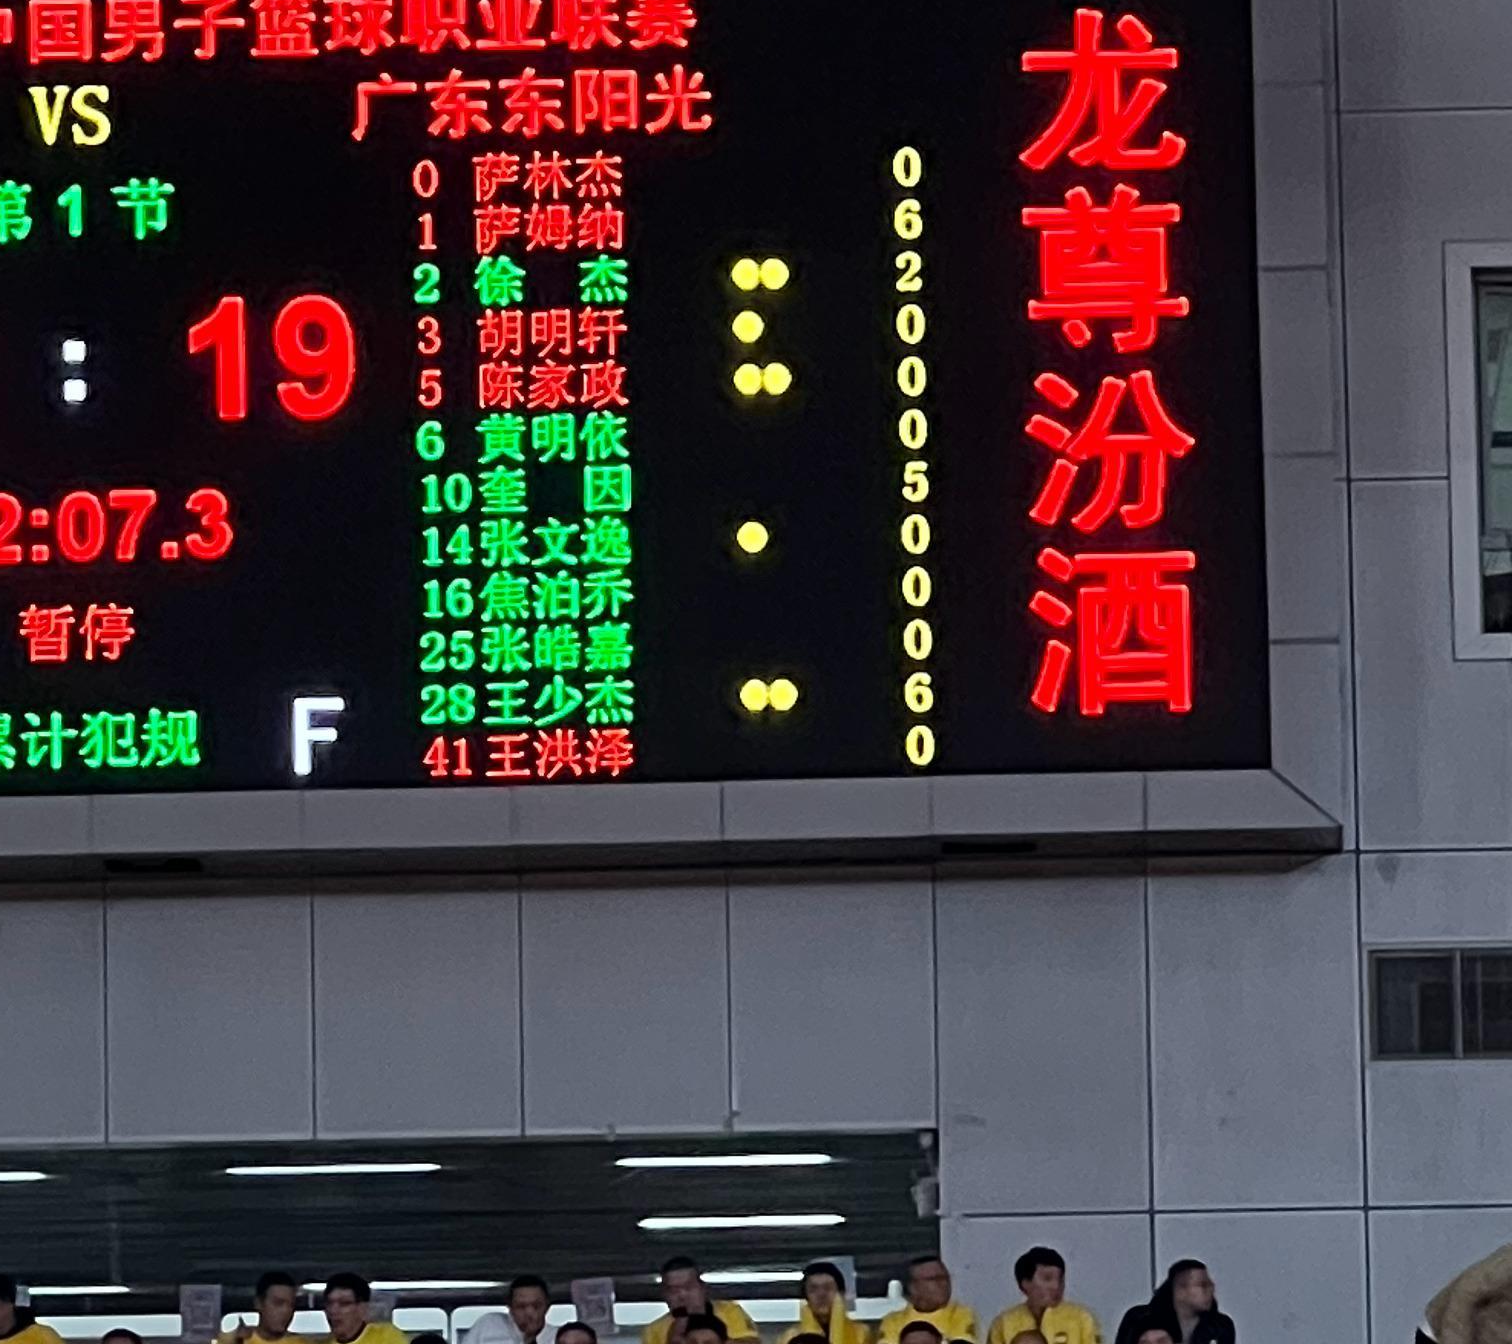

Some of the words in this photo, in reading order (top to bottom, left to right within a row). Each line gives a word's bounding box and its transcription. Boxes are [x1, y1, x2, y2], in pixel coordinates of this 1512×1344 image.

[28, 84, 112, 147] VS
[352, 64, 715, 143] 广东东阳光
[413, 157, 439, 197] 0
[472, 150, 623, 201] 萨林杰
[893, 147, 921, 187] 0
[419, 210, 437, 250] 1
[474, 202, 624, 254] 萨姆纳
[894, 199, 922, 240] 6
[414, 263, 440, 304] 2
[895, 251, 922, 292] 2
[188, 294, 357, 421] 19
[418, 316, 441, 354] 3
[477, 308, 628, 357] 胡明轩
[896, 304, 925, 344] 0
[419, 369, 441, 408] 5
[478, 360, 629, 409] 陈家政
[898, 356, 926, 397] 0
[1019, 8, 1196, 716] 龙尊汾酒
[416, 421, 445, 461] 6
[475, 411, 629, 463] 黄明依
[899, 409, 927, 449] 0
[422, 473, 472, 514] 10
[902, 461, 929, 502] 5
[423, 524, 473, 566] 14
[480, 516, 631, 568] 张文逸
[901, 514, 930, 554] 0
[424, 579, 473, 619] 16
[479, 569, 633, 621] 焦泊乔
[902, 566, 931, 607] 0
[19, 603, 136, 662] 暂停
[420, 631, 475, 672] 25
[481, 622, 634, 673] 张皓嘉
[904, 619, 932, 660] 0
[421, 683, 475, 724] 28
[482, 675, 634, 727] 王少杰
[905, 672, 933, 713] 6
[291, 696, 346, 777] F
[423, 736, 472, 776] 41
[485, 727, 634, 778] 王洪泽
[906, 726, 934, 766] 0
